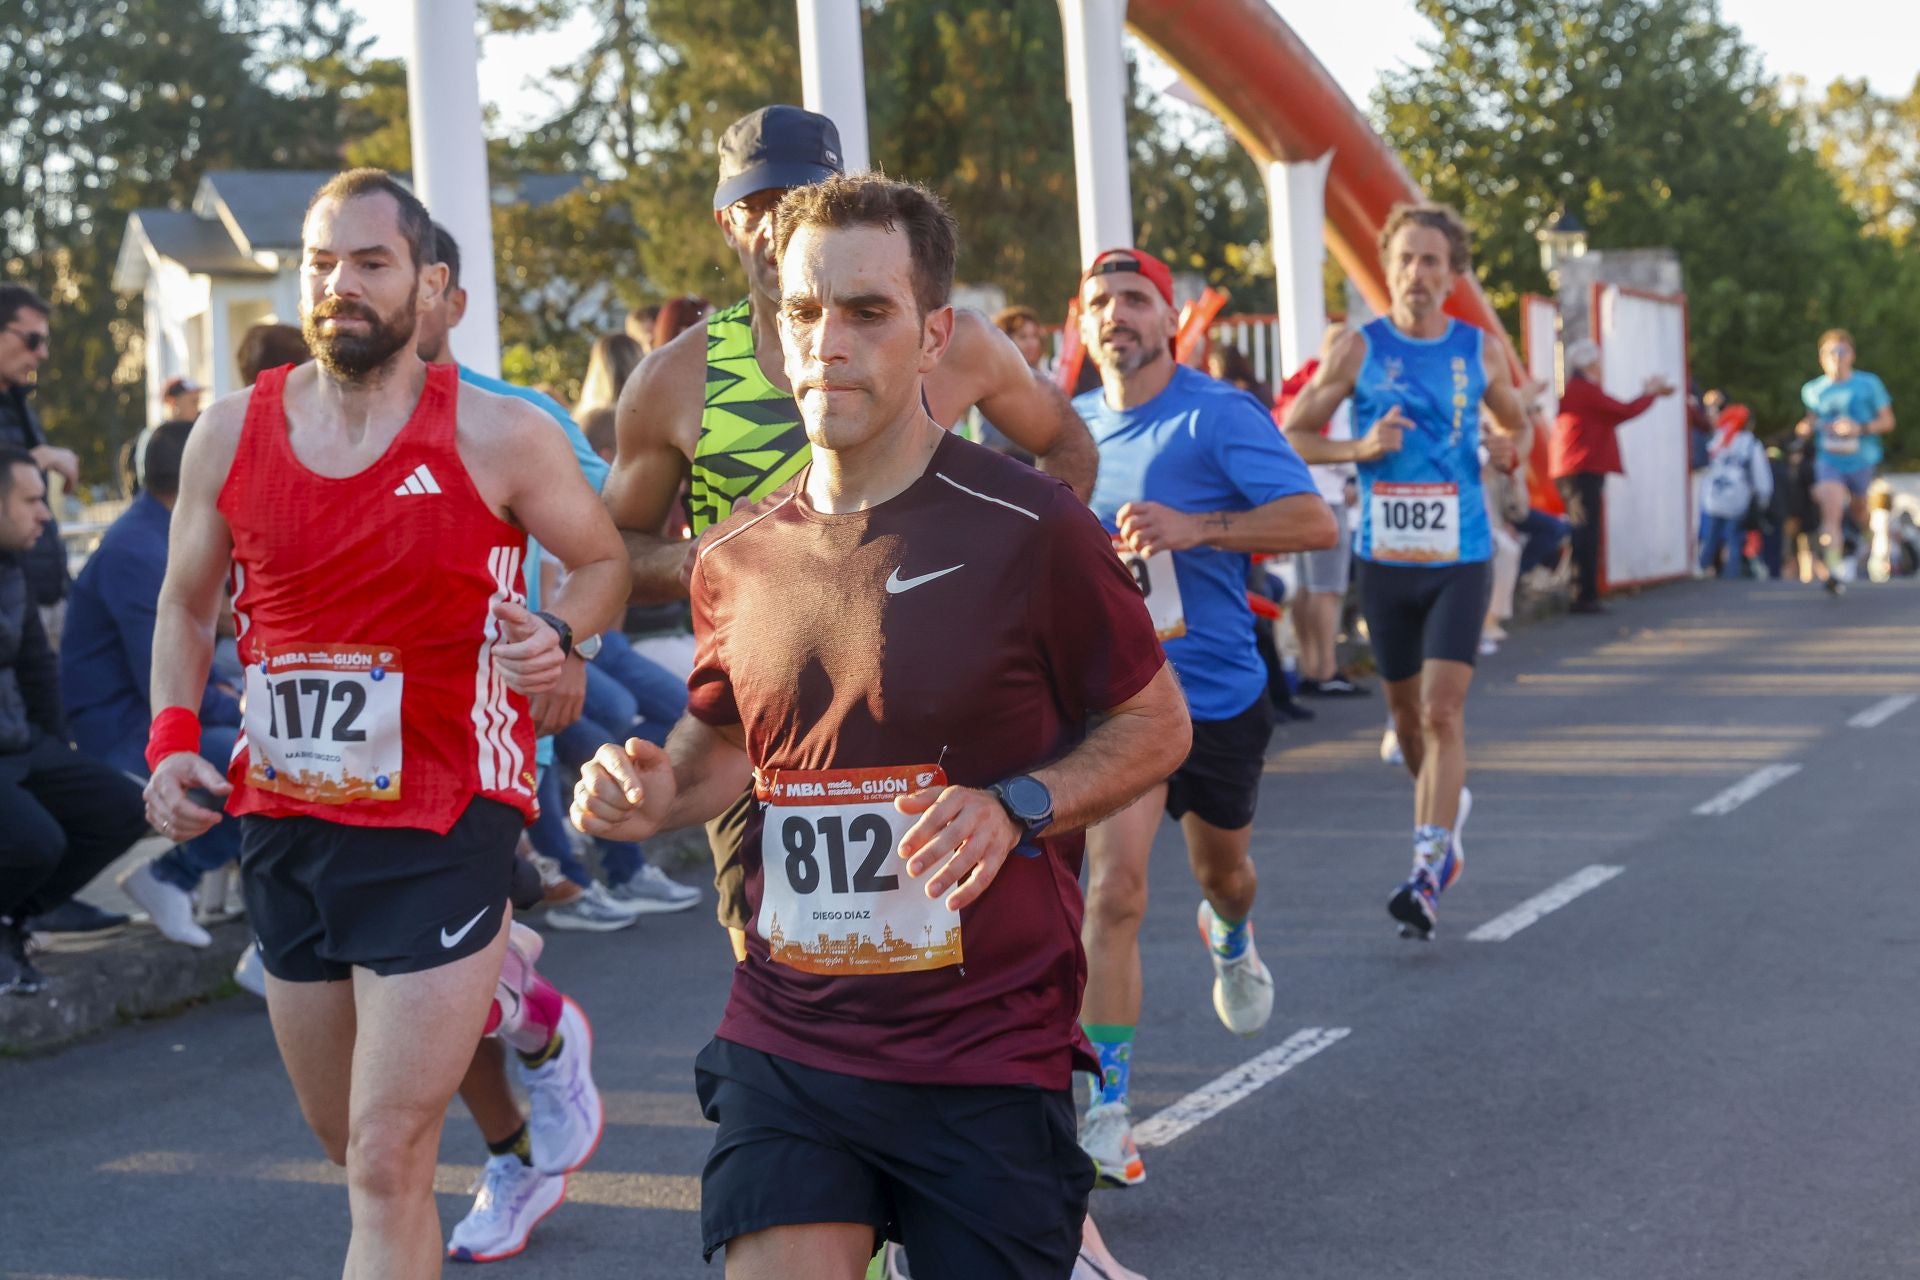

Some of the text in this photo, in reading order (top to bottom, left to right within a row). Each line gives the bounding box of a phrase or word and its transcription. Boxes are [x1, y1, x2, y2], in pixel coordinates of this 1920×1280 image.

[1381, 501, 1446, 530] 1082
[272, 652, 308, 667] MBA
[333, 651, 372, 665] GIJÓN
[266, 678, 367, 742] 1172
[786, 782, 826, 798] MBA
[861, 776, 908, 794] GIJÓN
[781, 813, 900, 895] 812
[812, 910, 871, 920] DIEGO DIAZ
